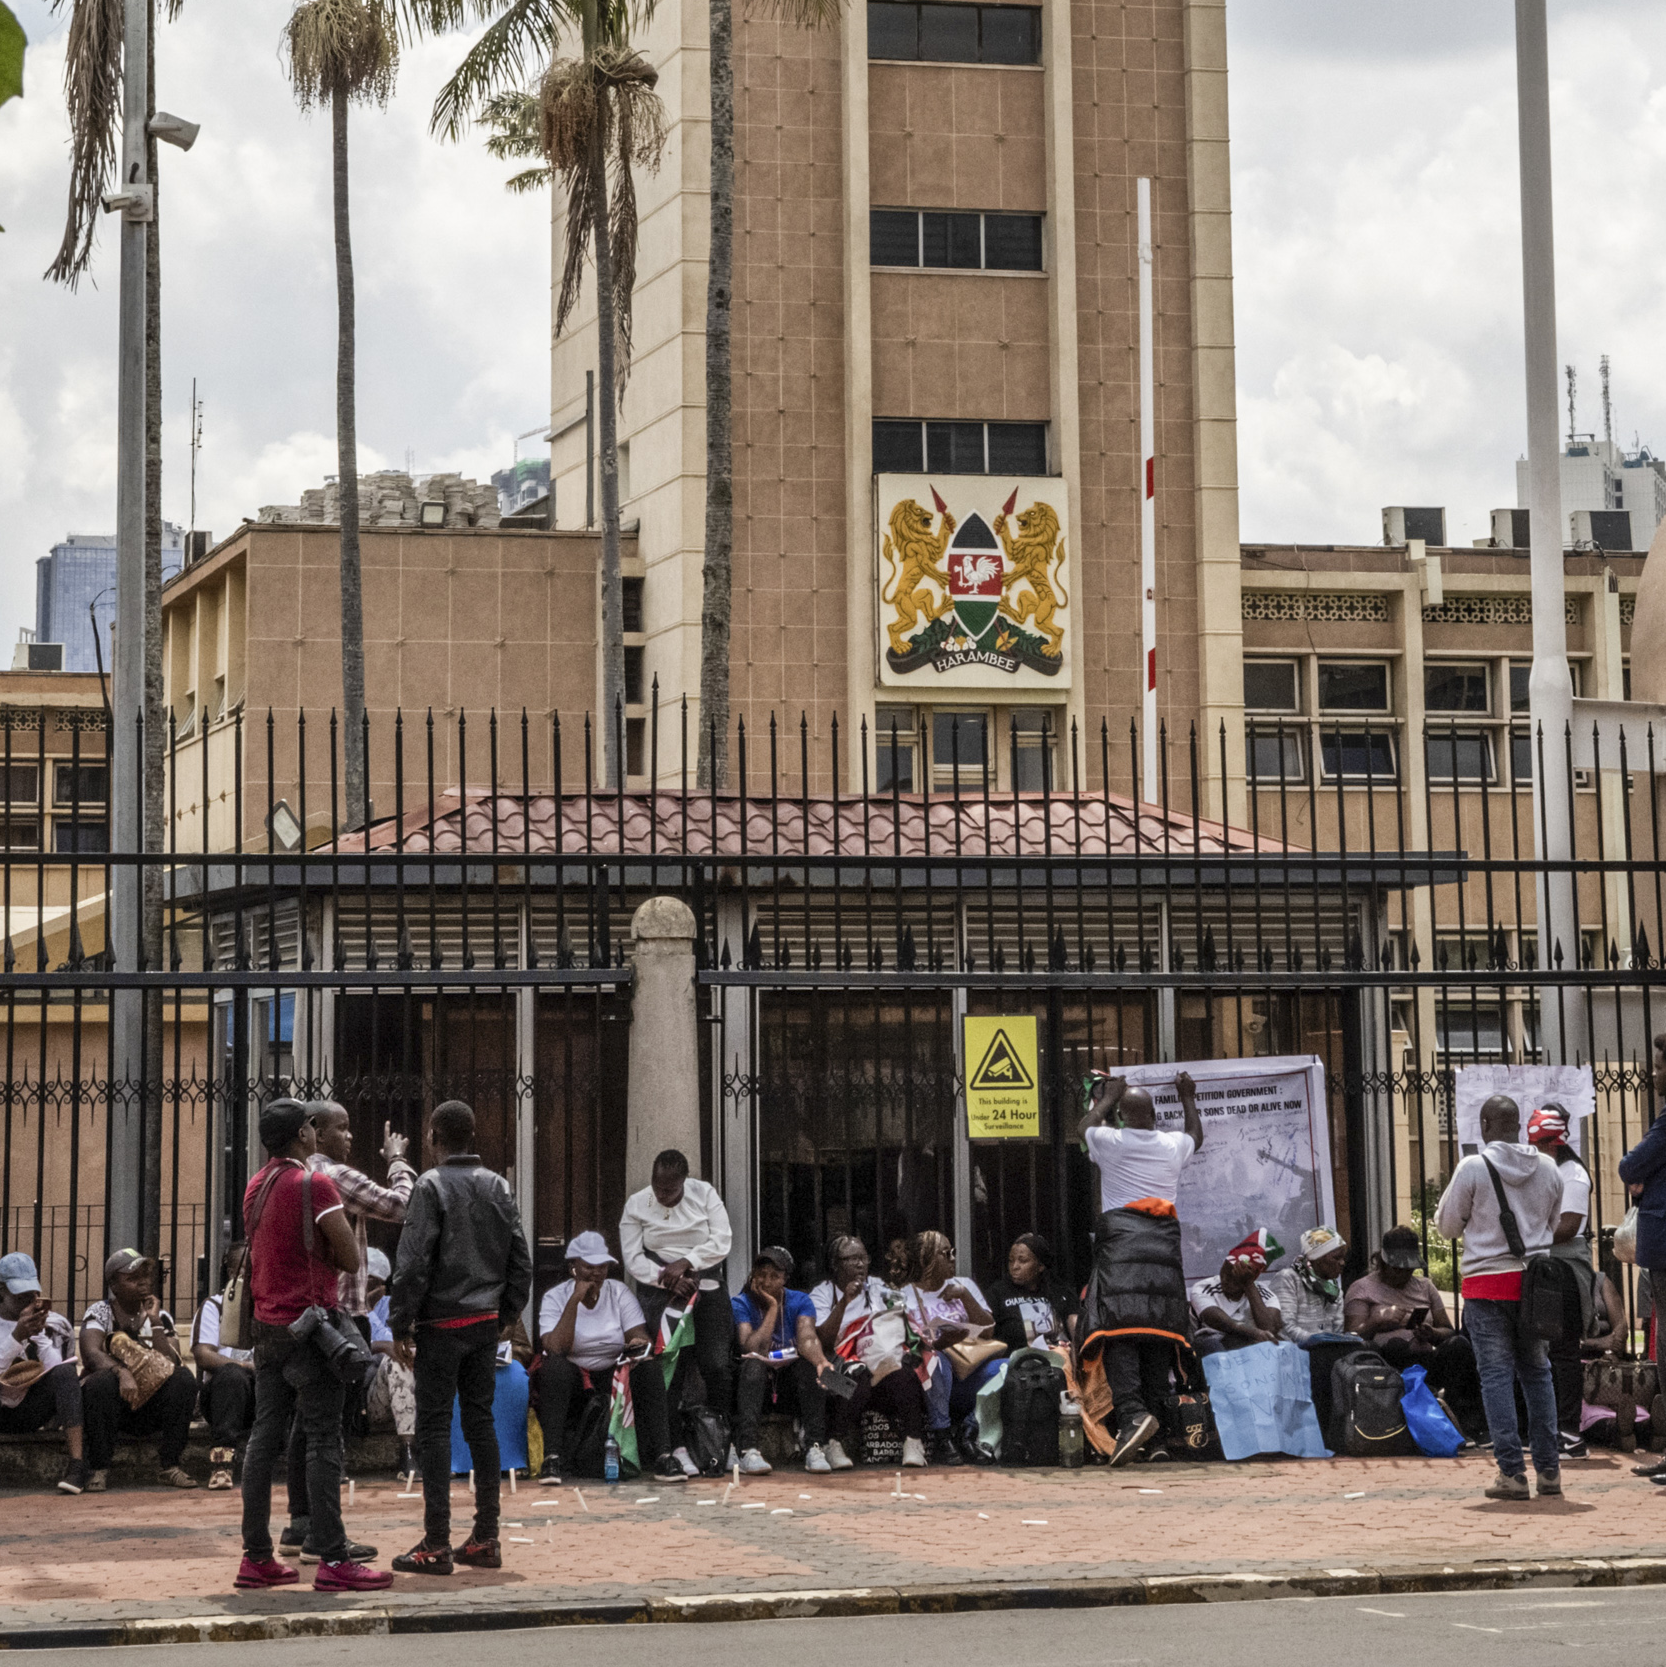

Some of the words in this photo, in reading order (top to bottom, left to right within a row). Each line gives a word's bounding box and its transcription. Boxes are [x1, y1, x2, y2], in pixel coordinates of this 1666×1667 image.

[936, 651, 1016, 672] HARAMBEE
[979, 1097, 992, 1105] This
[993, 1097, 1020, 1106] building
[1022, 1097, 1028, 1105] is
[1155, 1094, 1182, 1105] FAMILI
[1203, 1106, 1225, 1117] SONS
[1226, 1104, 1247, 1115] DEAD
[1248, 1103, 1259, 1113] OR
[1261, 1101, 1282, 1112] ALIVE
[1283, 1099, 1302, 1110] NOW
[971, 1113, 990, 1121] Under
[992, 1109, 1007, 1120] 24
[1010, 1109, 1037, 1120] Hour
[984, 1122, 1024, 1130] Surveillance
